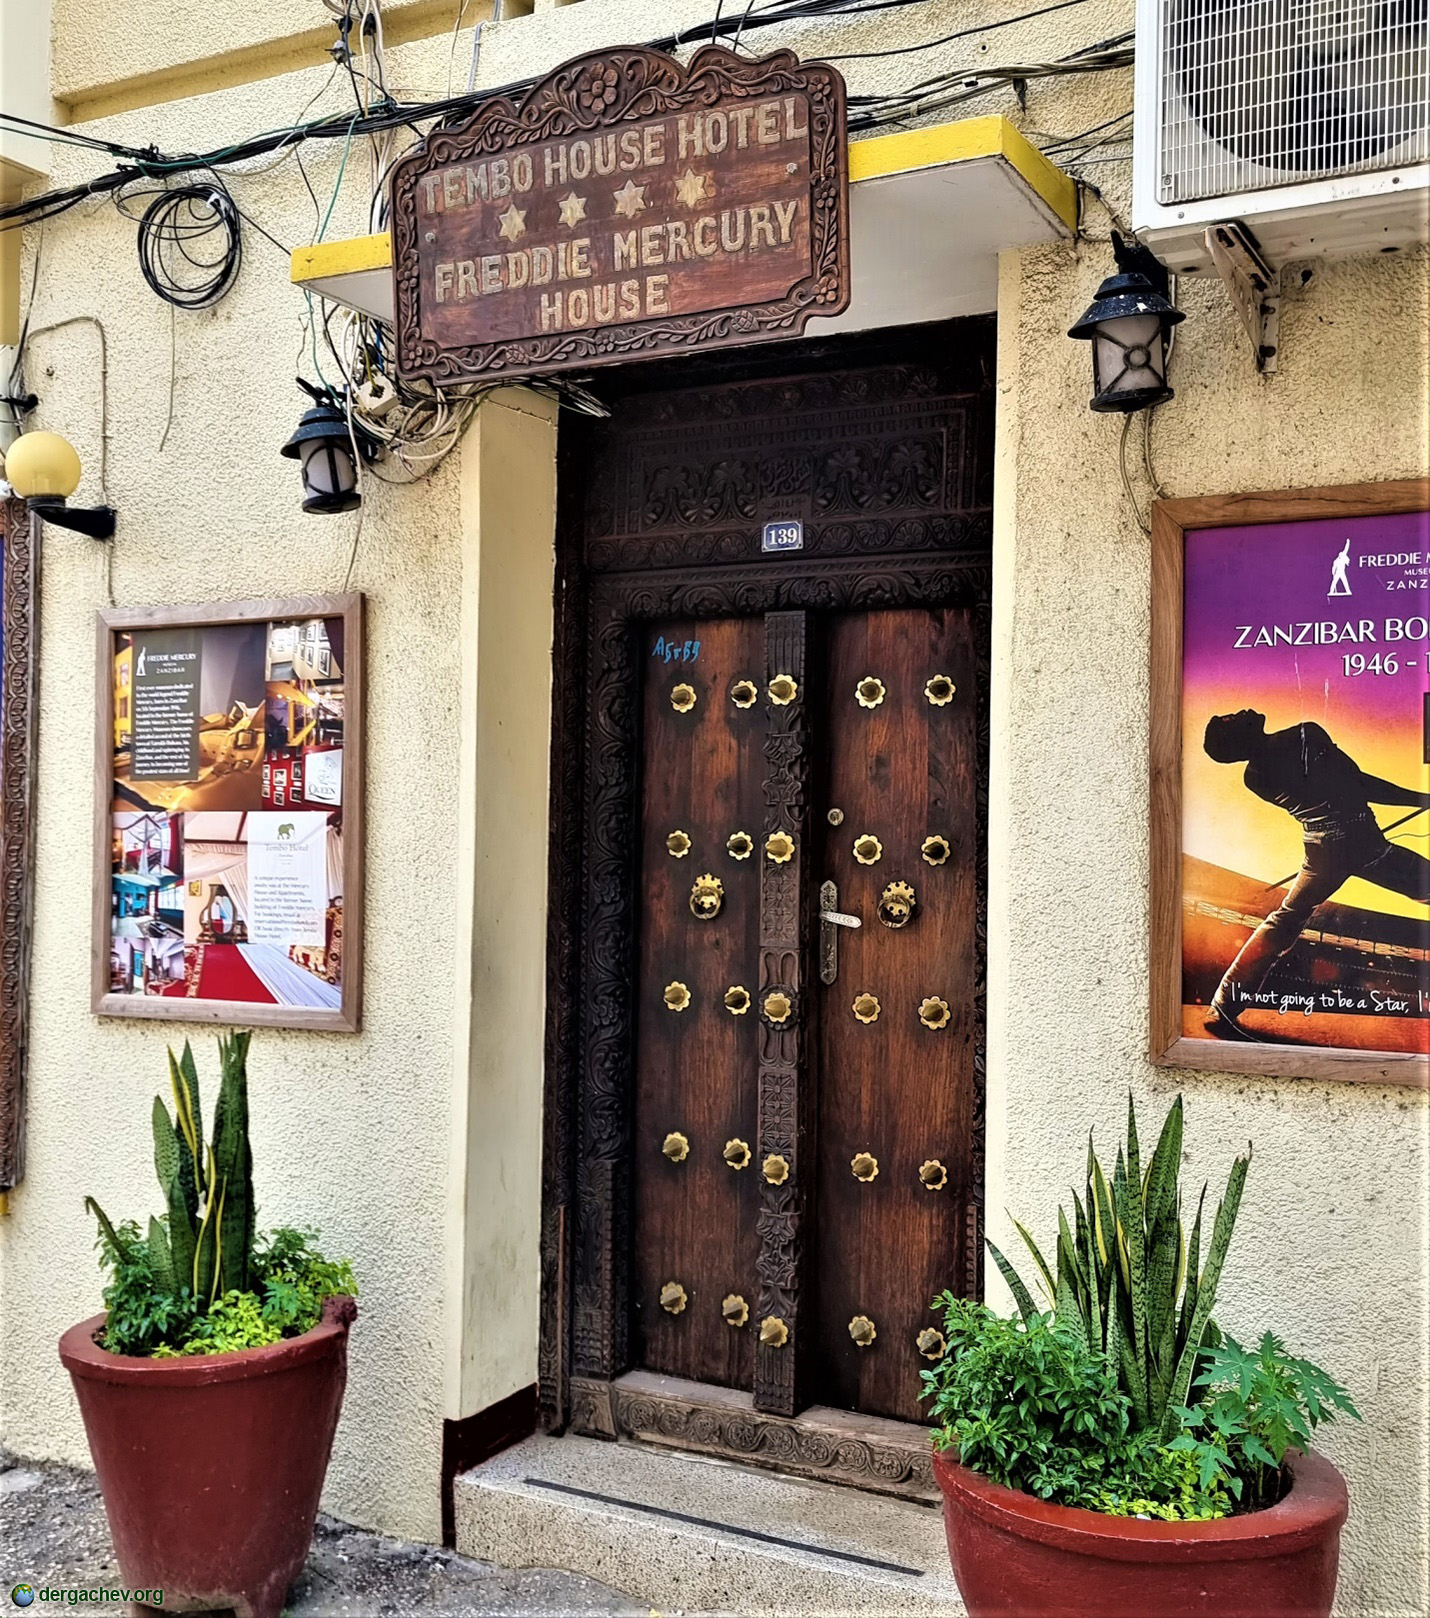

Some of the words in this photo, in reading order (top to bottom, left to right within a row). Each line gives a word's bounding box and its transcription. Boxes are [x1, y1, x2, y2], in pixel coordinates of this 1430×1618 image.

[419, 153, 534, 213] TEMBO
[544, 124, 666, 187] HOUSE
[677, 97, 809, 160] HOTEL
[435, 238, 592, 303] FREDDIE
[613, 200, 798, 272] MERCURY
[540, 274, 671, 332] HOUSE
[769, 528, 797, 545] 139
[1359, 552, 1421, 567] FREDDIE
[1403, 567, 1430, 577] MUSE
[1233, 620, 1376, 649] ZANZIBAR
[1385, 616, 1430, 642] BO
[1341, 652, 1399, 677] 1946
[1255, 991, 1278, 1004] not
[1278, 993, 1314, 1015] going
[1319, 993, 1334, 1008] to
[1338, 989, 1354, 1008] be
[1357, 999, 1368, 1008] a
[1370, 990, 1410, 1014] Star,
